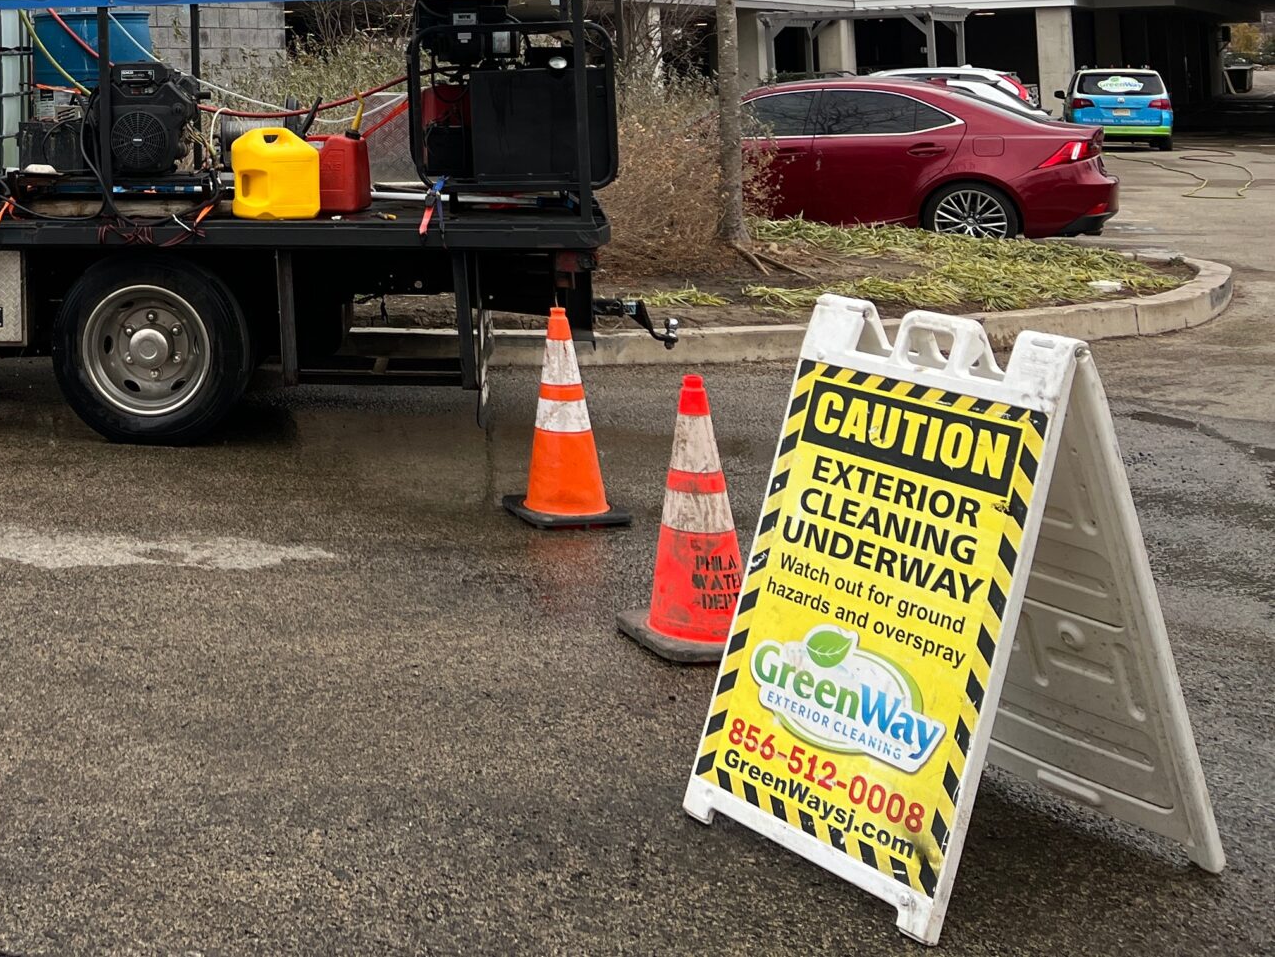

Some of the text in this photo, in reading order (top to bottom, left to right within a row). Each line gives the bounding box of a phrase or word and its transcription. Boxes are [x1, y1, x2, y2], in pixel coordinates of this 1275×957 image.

[813, 391, 1011, 480] CAUTION
[800, 488, 978, 566] CLEANING
[812, 455, 981, 528] EXTERIOR
[695, 554, 738, 571] PHILA
[780, 552, 966, 634] Watch out for ground
[782, 515, 985, 604] UNDERWAY
[766, 576, 966, 669] hazards and overspray
[754, 644, 940, 760] GreenWay
[766, 691, 903, 761] EXTERIOR CLEANING
[724, 748, 915, 859] GreenWaysj.com
[728, 718, 926, 834] 856-512-0008
